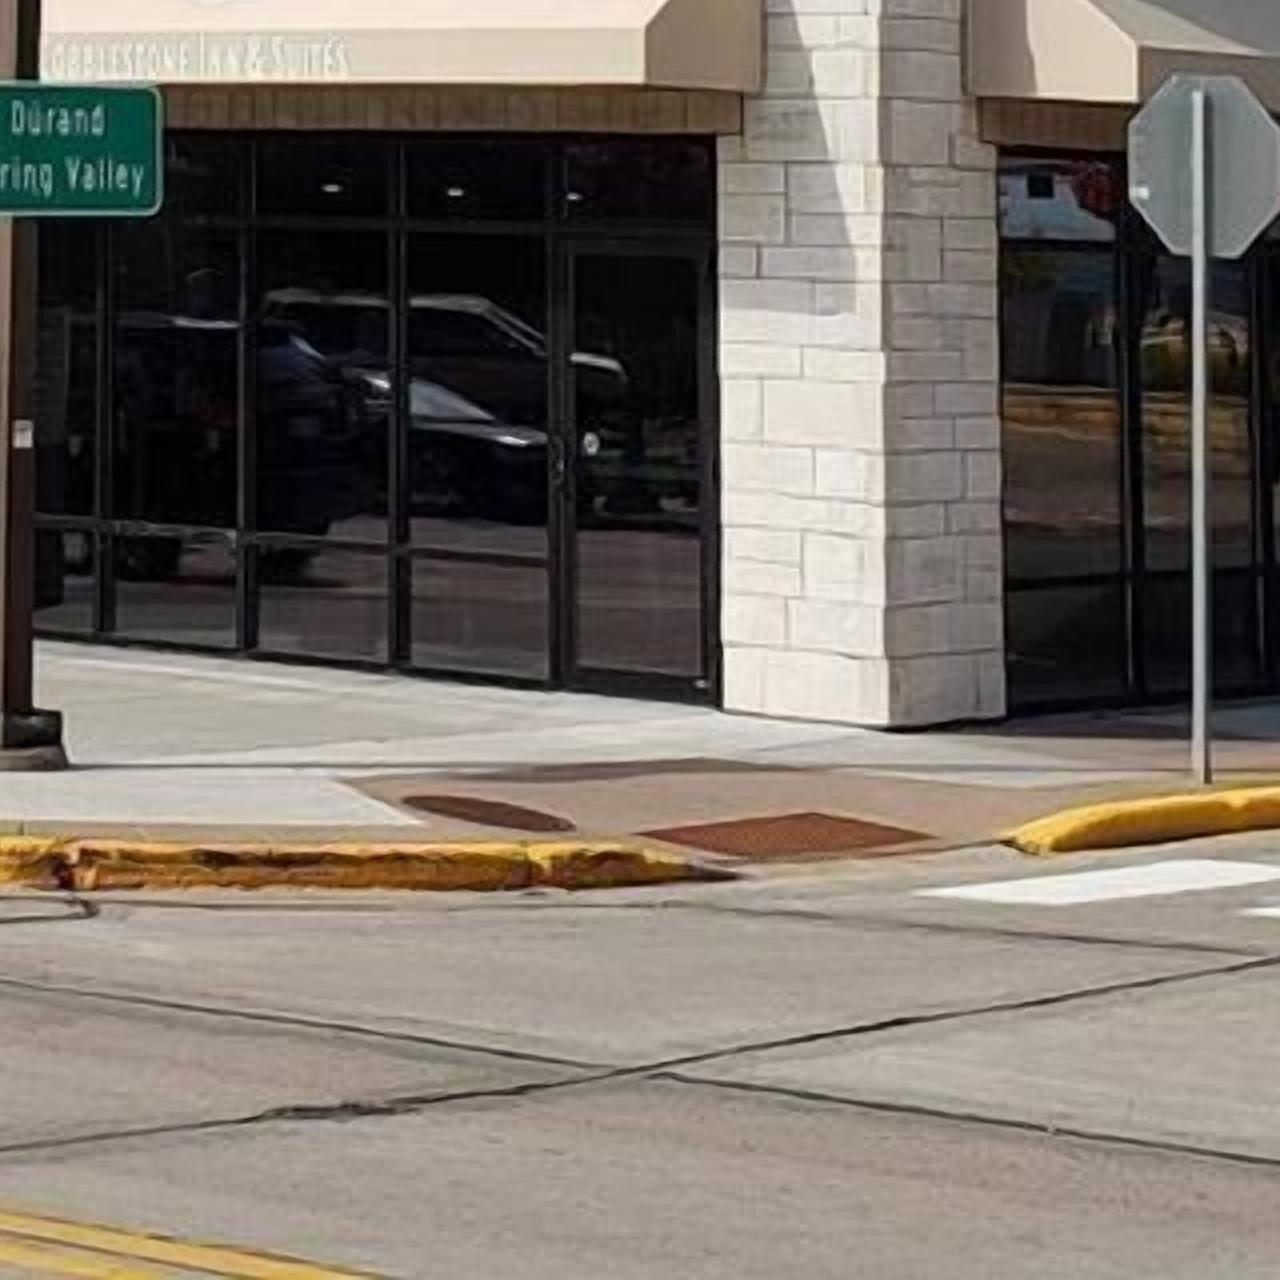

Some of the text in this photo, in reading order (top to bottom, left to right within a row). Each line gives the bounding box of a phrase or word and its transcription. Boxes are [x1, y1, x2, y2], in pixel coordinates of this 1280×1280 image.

[42, 40, 189, 78] OBBLESTONE
[11, 99, 105, 136] Durand
[65, 156, 145, 198] Valley
